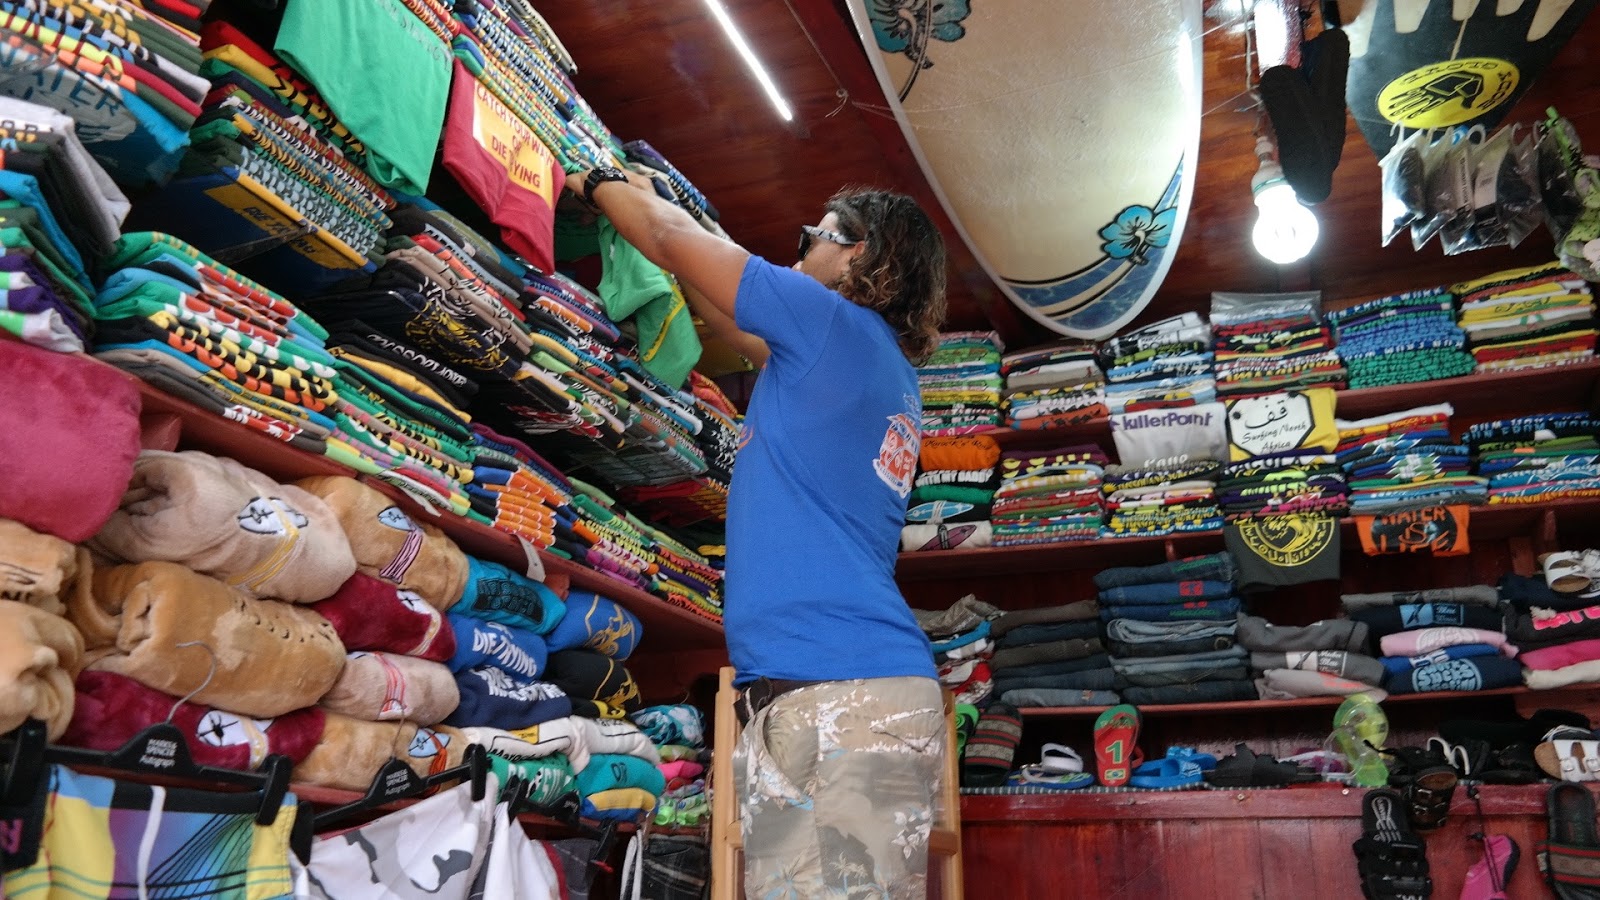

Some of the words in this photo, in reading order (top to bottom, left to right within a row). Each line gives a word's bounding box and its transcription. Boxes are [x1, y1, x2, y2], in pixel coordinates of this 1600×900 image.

[476, 83, 507, 122] CATCH
[508, 114, 531, 146] YOUR
[491, 135, 507, 160] DIE
[1242, 429, 1278, 445] Surfing
[1279, 422, 1307, 436] North
[1261, 441, 1291, 454] Africa
[472, 627, 498, 655] DIE
[1105, 739, 1124, 765] 1
